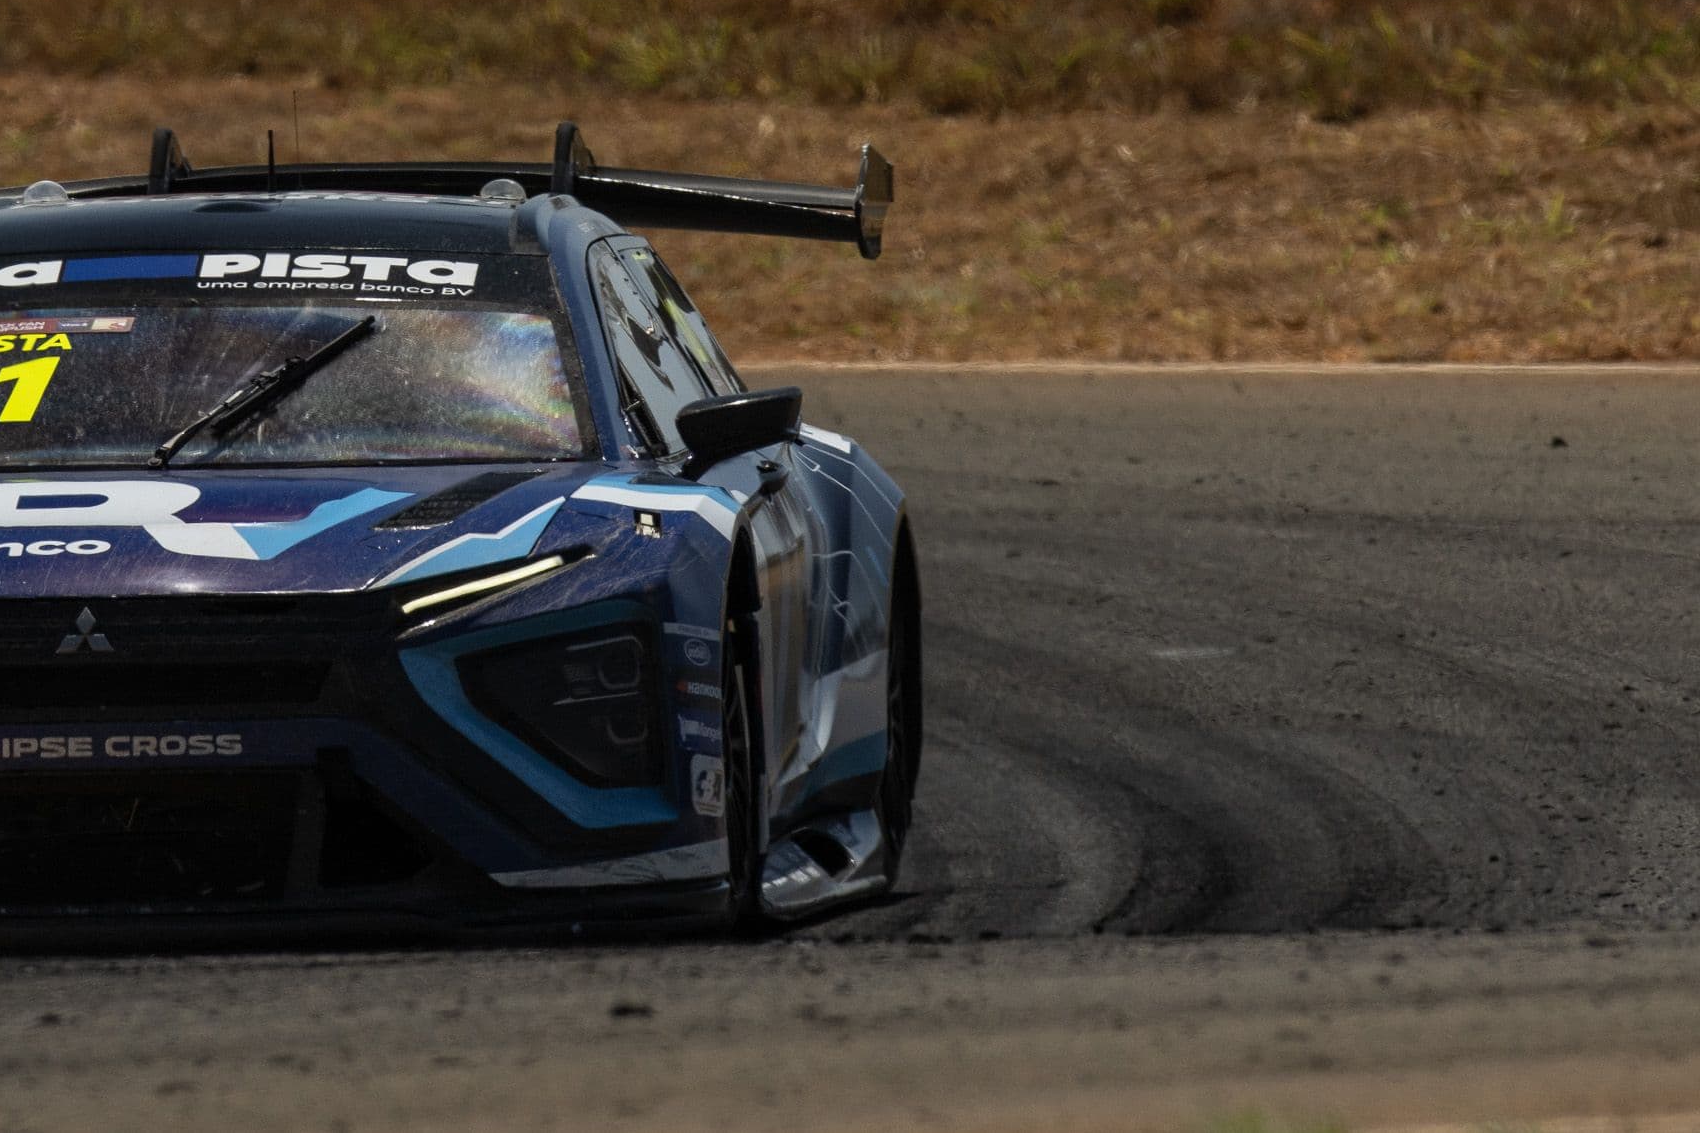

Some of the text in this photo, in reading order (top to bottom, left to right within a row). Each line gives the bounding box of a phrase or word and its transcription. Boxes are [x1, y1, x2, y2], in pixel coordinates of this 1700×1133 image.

[197, 280, 475, 297] uma empresa banco BV
[104, 734, 244, 757] CROSS
